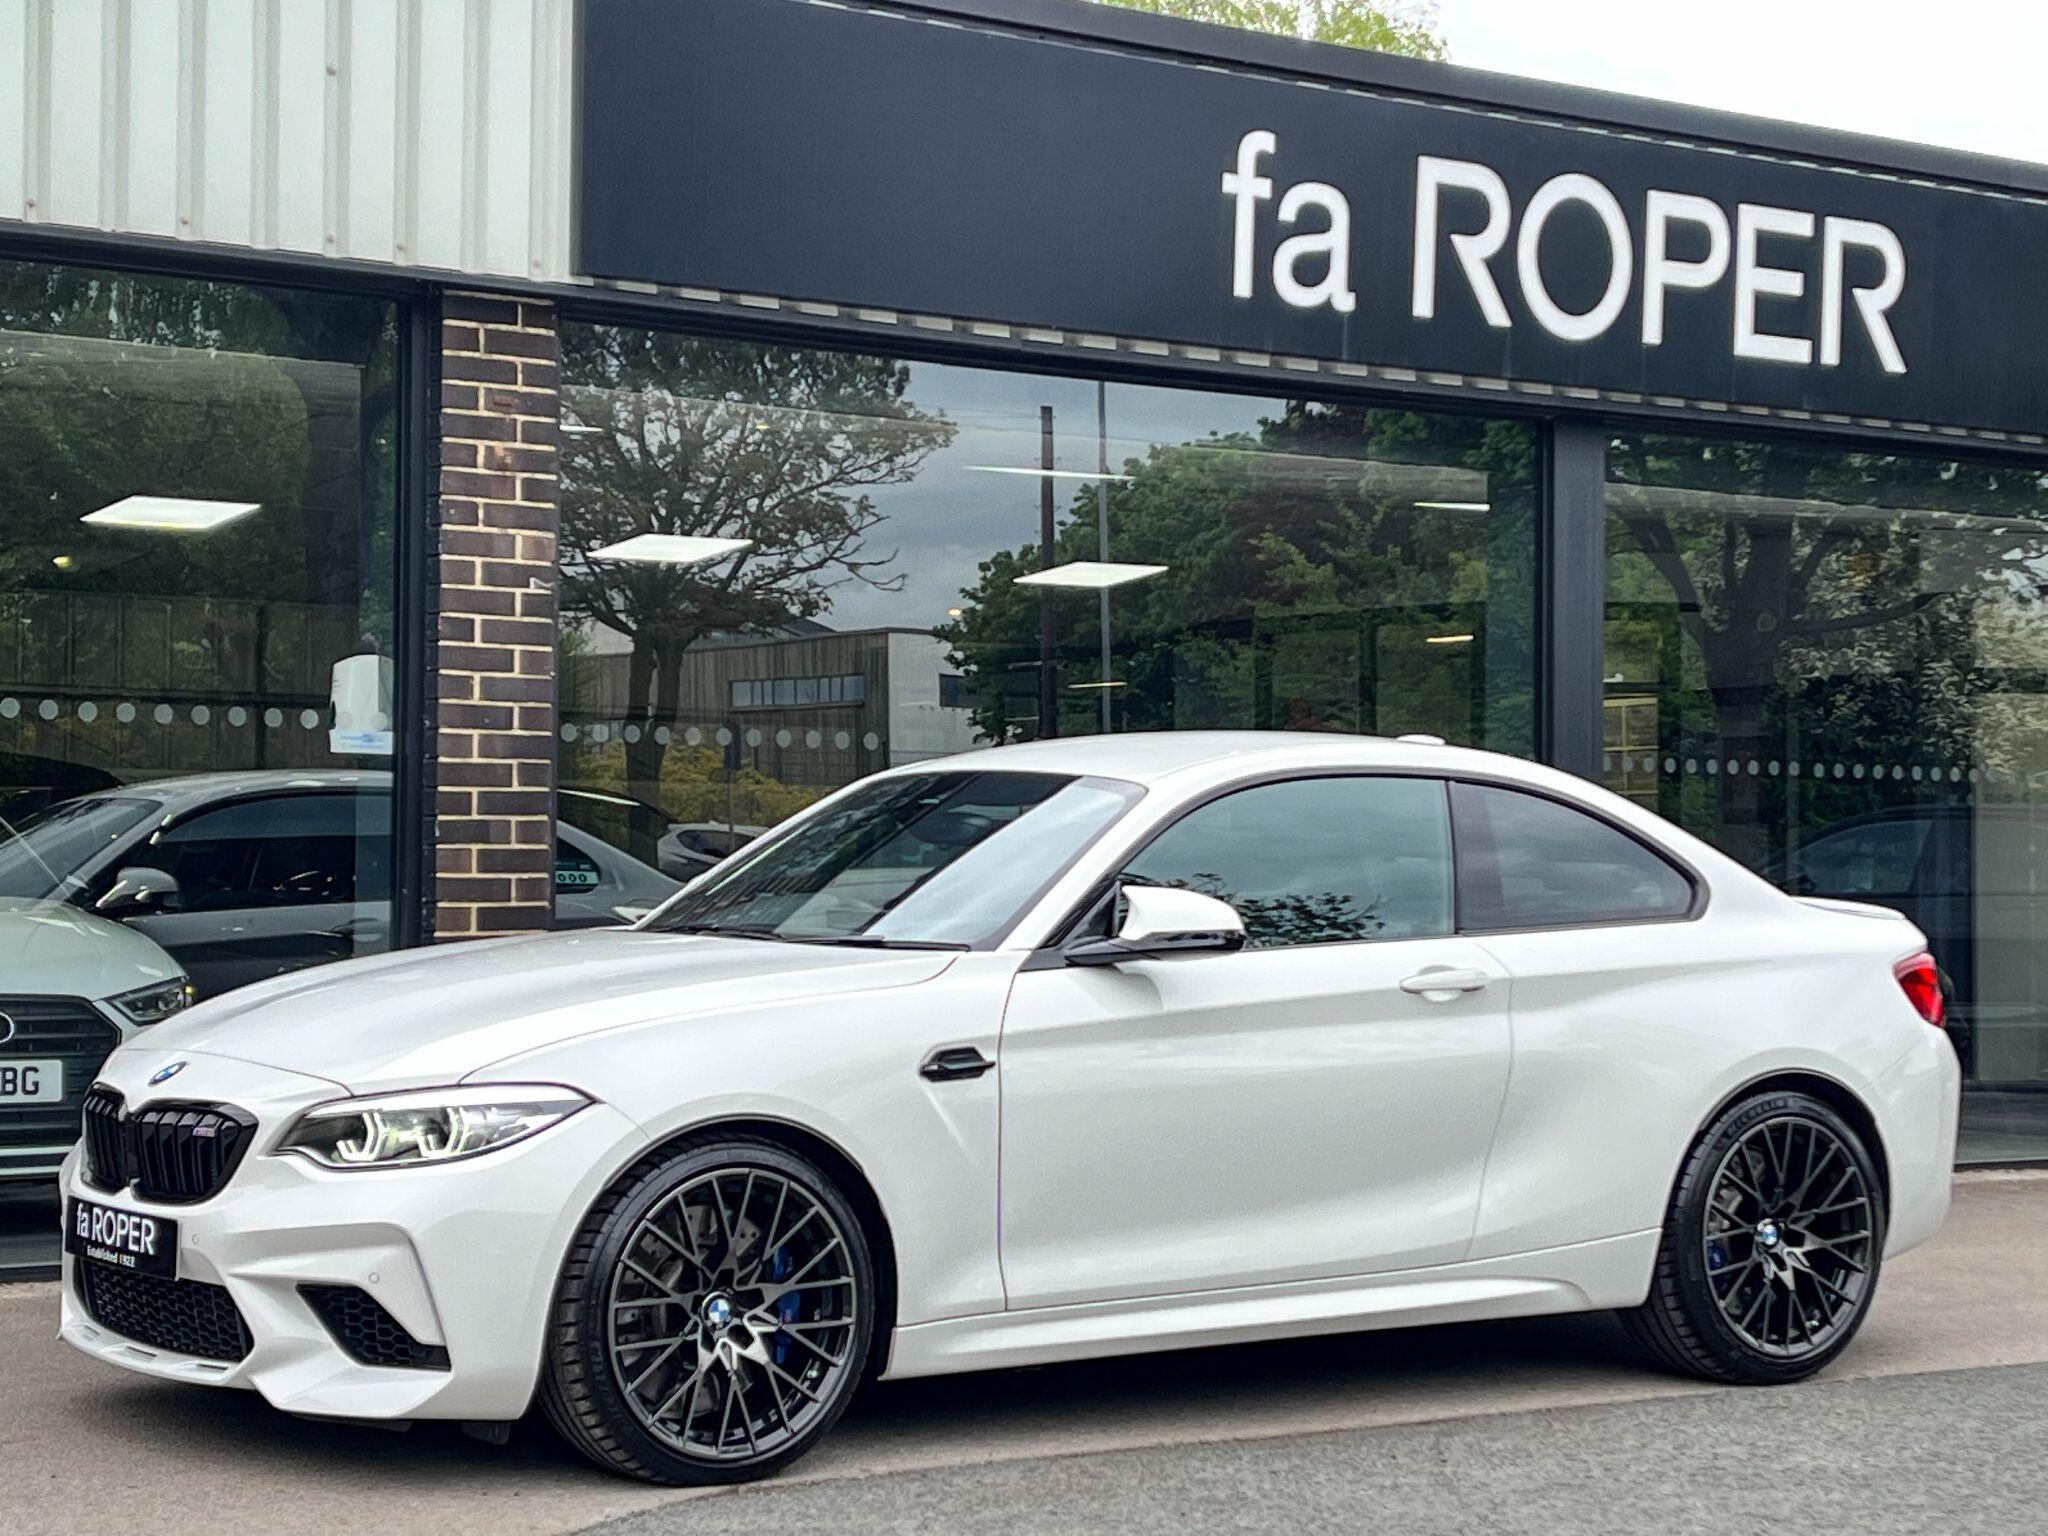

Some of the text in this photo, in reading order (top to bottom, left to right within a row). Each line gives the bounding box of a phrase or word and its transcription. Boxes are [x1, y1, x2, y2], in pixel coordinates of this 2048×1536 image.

[1221, 129, 1907, 374] fa ROPER
[76, 1202, 155, 1256] fa ROPER
